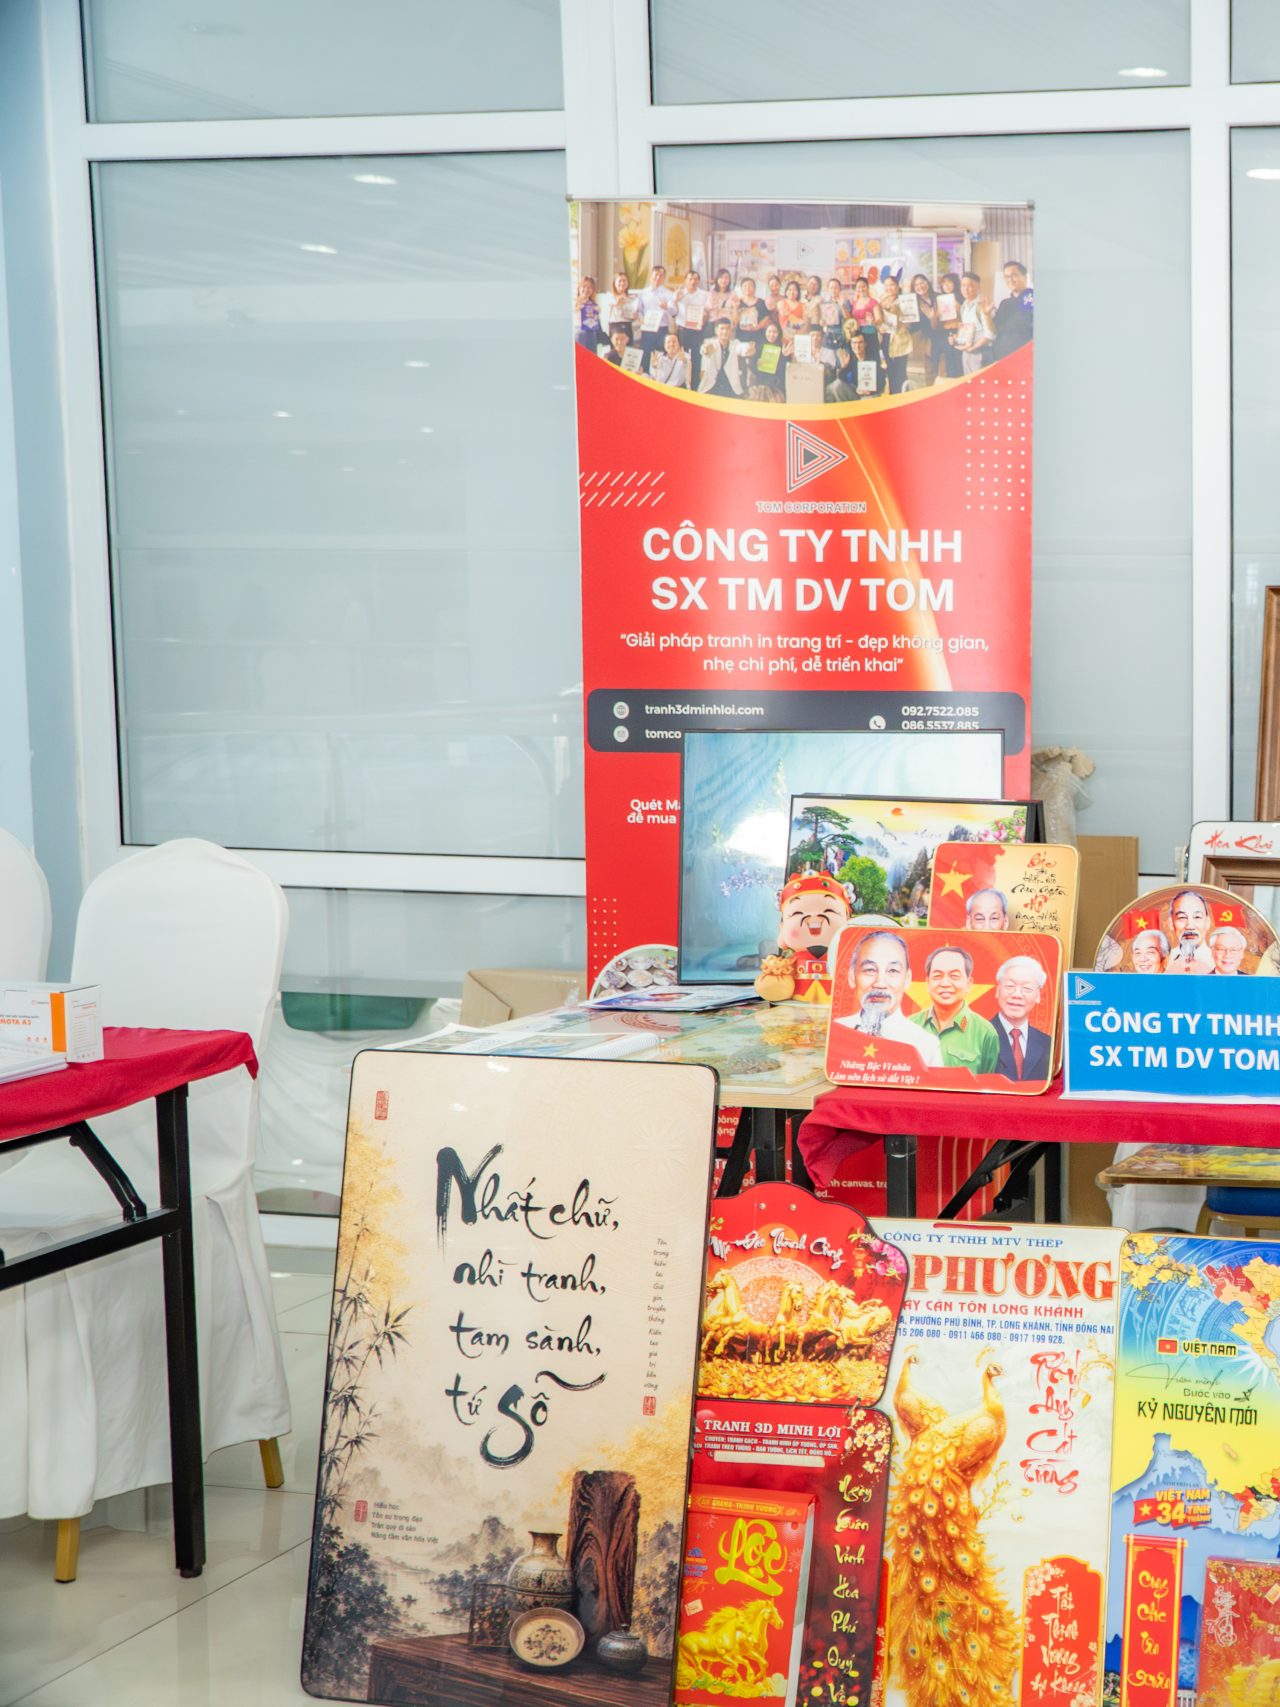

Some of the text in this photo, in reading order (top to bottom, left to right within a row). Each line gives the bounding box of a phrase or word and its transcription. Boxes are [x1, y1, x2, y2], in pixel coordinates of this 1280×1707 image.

[756, 501, 866, 513] TOM CORPORATION
[643, 519, 962, 562] CÔNG TY TNHH
[651, 577, 954, 611] SX TM DV TOM
[660, 633, 703, 651] pháp
[707, 634, 753, 648] tranh
[757, 634, 772, 648] in
[777, 635, 822, 651] trang
[826, 634, 842, 648] trí
[858, 634, 888, 652] đẹp
[892, 634, 943, 651] không
[948, 636, 989, 653] gian,
[703, 657, 734, 673] nhẹ
[738, 657, 764, 671] chi
[768, 657, 798, 675] phí,
[802, 656, 822, 671] dễ
[826, 656, 860, 671] triển
[645, 704, 764, 715] tranh3dminhloi.com
[901, 706, 979, 716] 092.7522.085
[630, 799, 663, 812] Quét
[647, 815, 677, 824] mua
[1084, 1007, 1161, 1034] CÔNG
[1167, 1012, 1201, 1034] TY
[1089, 1045, 1280, 1070] SX TM DV TOM
[436, 1143, 557, 1252] Nhất
[883, 1231, 921, 1242] CÔNG
[927, 1234, 944, 1243] TY
[949, 1235, 987, 1245] TNHH
[992, 1237, 1022, 1246] MTV
[521, 1254, 606, 1302] tranh,
[910, 1252, 1118, 1301] PHƯƠNG
[958, 1301, 987, 1313] TÔN
[992, 1304, 1028, 1316] LONG
[1034, 1305, 1083, 1319] KHÁNH
[449, 1310, 510, 1359] tam
[910, 1329, 1065, 1344] 206 080 0911 466 080 0917 199 928.
[987, 1319, 997, 1329] TP.
[1000, 1320, 1020, 1329] LONG
[1100, 1325, 1115, 1335] NAI
[1183, 1340, 1208, 1357] VIỆT
[1138, 1397, 1257, 1427] KỶ NGUYÊN MỚI
[704, 1419, 841, 1440] TRANH 3D MINH LỢI
[1155, 1487, 1211, 1502] VIỆT NAM
[1156, 1501, 1187, 1525] 34
